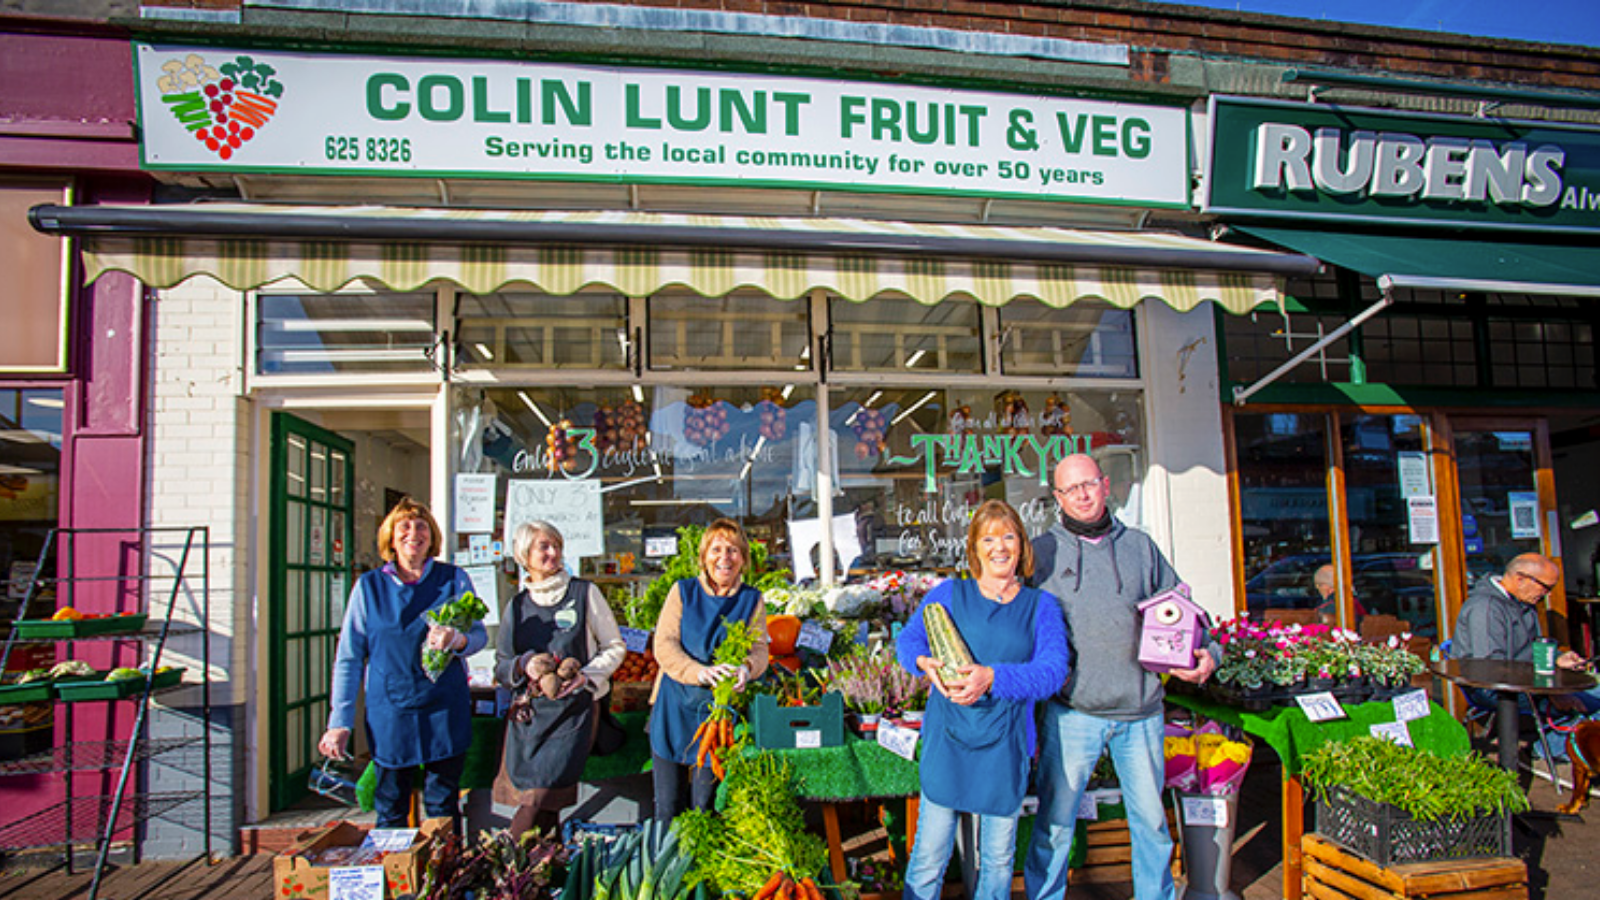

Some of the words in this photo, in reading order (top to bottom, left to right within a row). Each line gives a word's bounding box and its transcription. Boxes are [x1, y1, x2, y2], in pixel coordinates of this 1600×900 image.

[365, 72, 593, 127] COLIN
[624, 83, 812, 136] LUNT
[840, 94, 989, 147] FRUIT
[1006, 107, 1040, 151] &
[1055, 111, 1152, 159] VEG
[324, 135, 359, 161] 625
[365, 137, 411, 162] 8326
[484, 135, 593, 164] Serving
[605, 139, 651, 162] the
[662, 141, 726, 165] local
[735, 149, 879, 175] community
[888, 153, 926, 173] for
[933, 160, 989, 177] over
[997, 160, 1031, 179] 50
[1039, 166, 1105, 186] years
[1253, 121, 1565, 206] RUBENS
[560, 428, 598, 480] 3
[910, 434, 1036, 493] THANK
